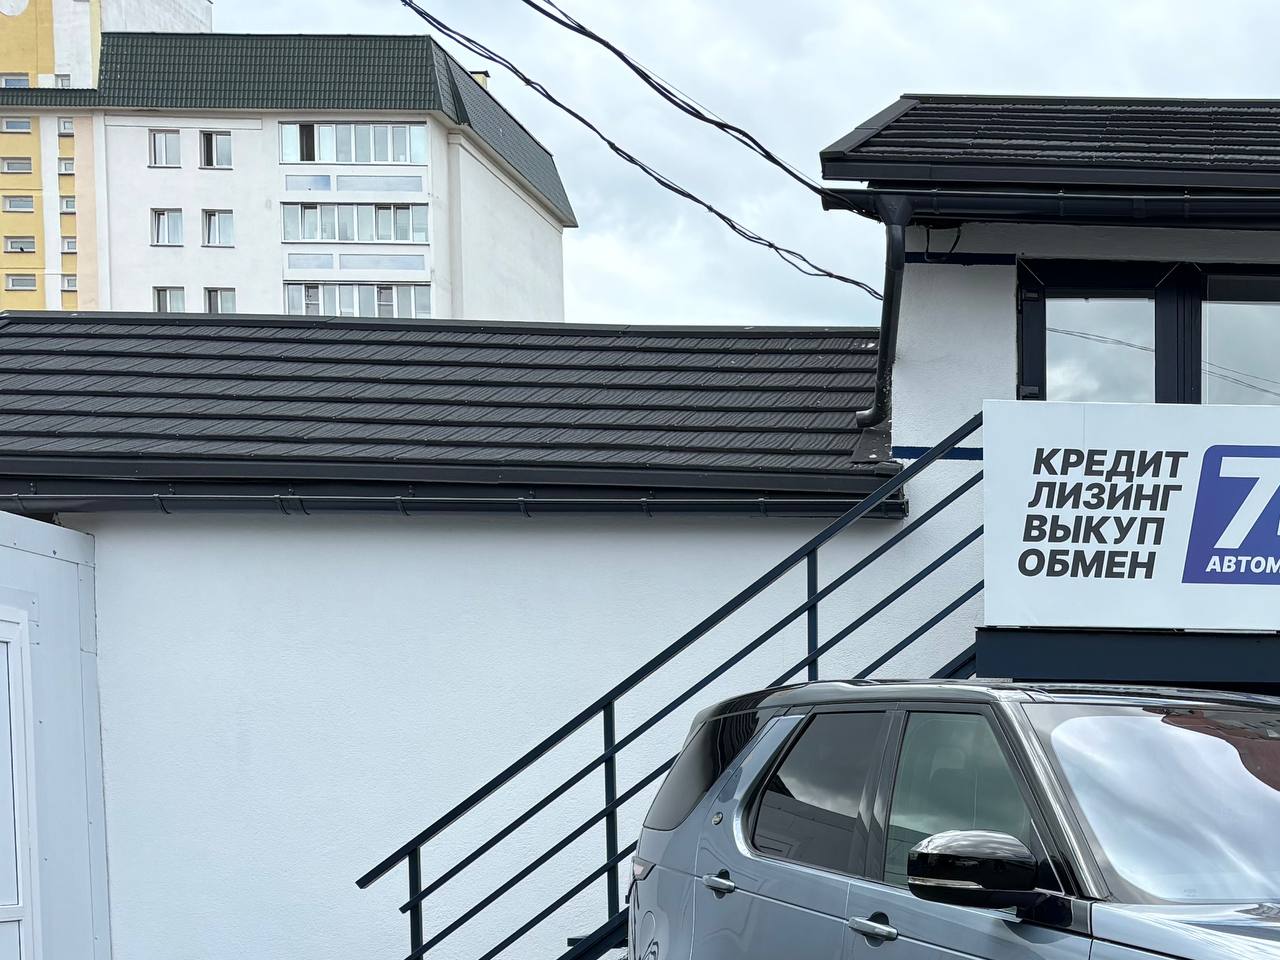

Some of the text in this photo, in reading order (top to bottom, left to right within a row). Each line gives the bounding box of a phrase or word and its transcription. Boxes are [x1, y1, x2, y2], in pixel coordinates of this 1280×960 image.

[1032, 448, 1188, 481] КРЕДИТ
[1027, 481, 1183, 512] ЛИЗИНГ
[1022, 514, 1165, 545] ВЫКУП
[1017, 548, 1157, 580] ОБМЕН
